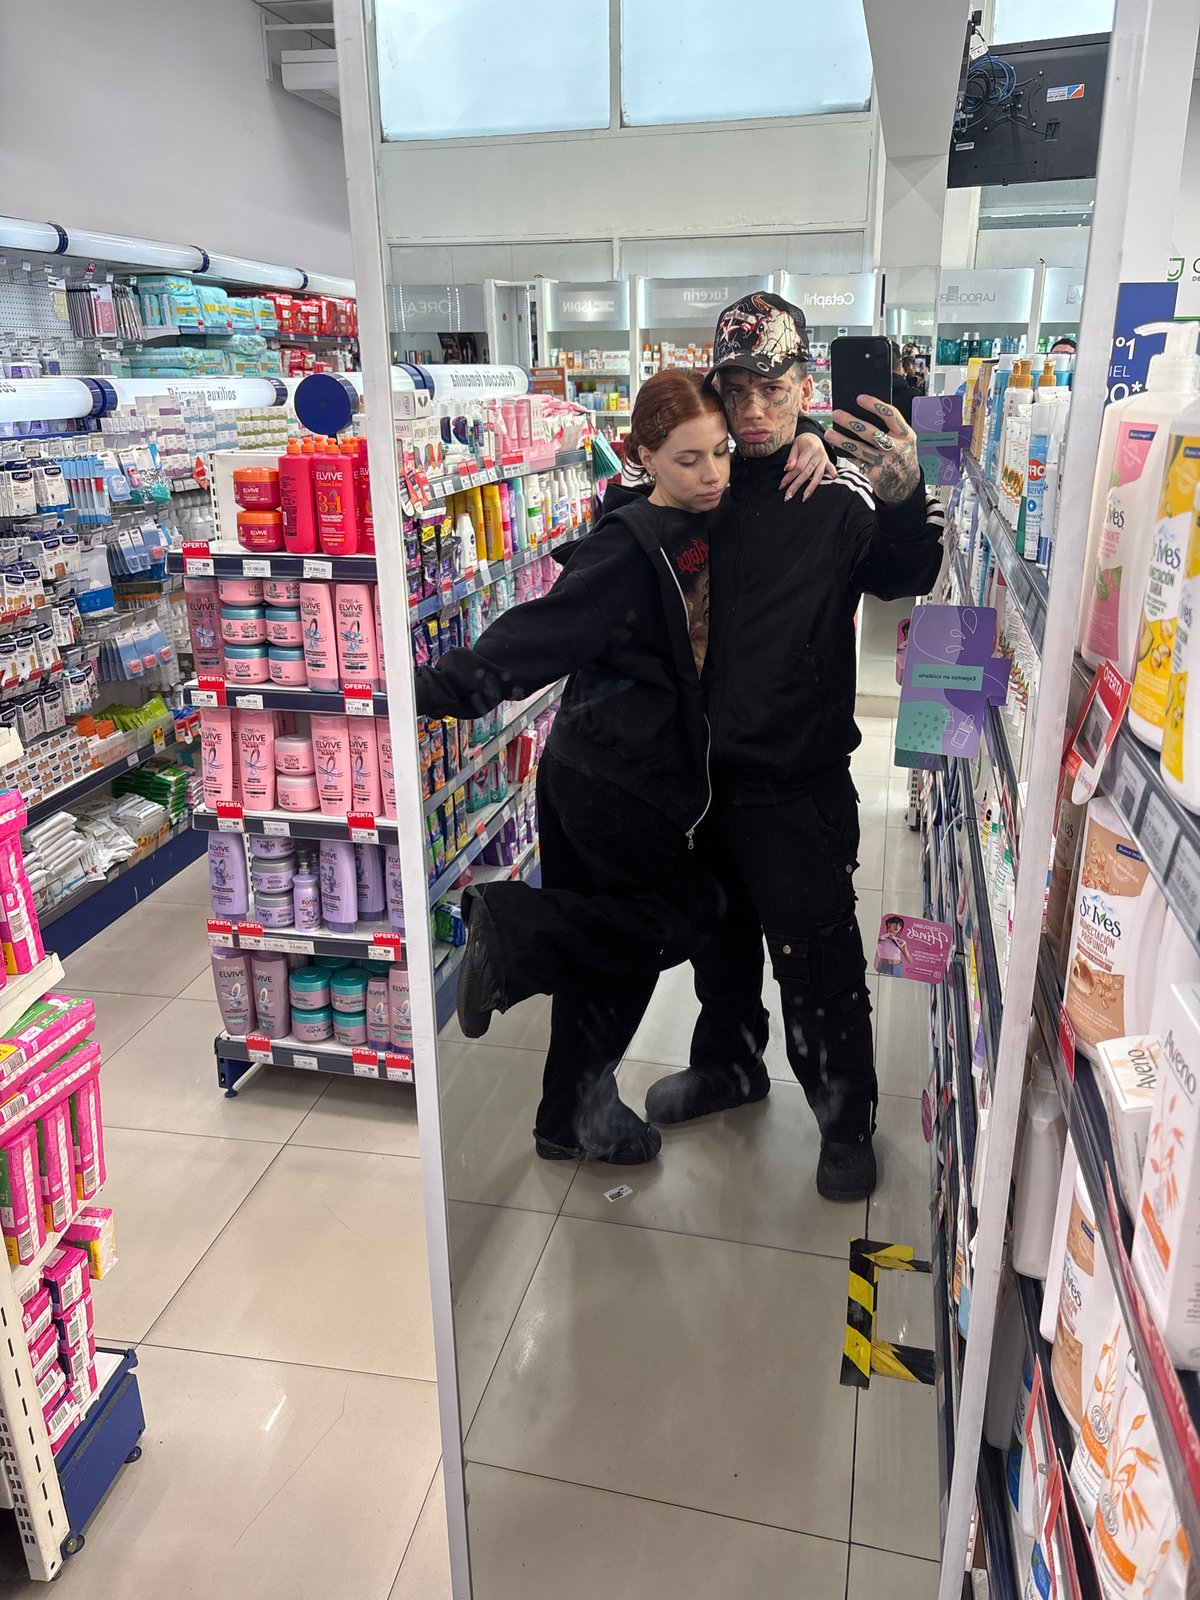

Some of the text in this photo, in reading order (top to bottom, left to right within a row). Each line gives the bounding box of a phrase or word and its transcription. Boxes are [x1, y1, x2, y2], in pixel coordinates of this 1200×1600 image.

[1108, 365, 1131, 378] IEL
[207, 386, 237, 401] auxilios
[316, 471, 343, 480] ELVIVE
[1157, 539, 1180, 569] Ives
[190, 602, 216, 611] ELVIVE
[301, 602, 321, 610] ELVIVE
[1102, 666, 1124, 700] OFERTA
[201, 733, 222, 741] ELVIVE
[241, 733, 266, 741] ELVIVE
[316, 741, 342, 749] ELVIVE
[209, 844, 230, 852] ELVIVE
[320, 852, 338, 860] ELVIVE
[1092, 904, 1121, 938] Ives
[1080, 917, 1115, 950] HUMECTACIÓN
[1081, 930, 1108, 957] PROFUNDA
[219, 969, 245, 978] ELVIVE
[368, 989, 386, 997] ELVIVE
[392, 985, 409, 993] ELVIV
[246, 1034, 269, 1042] OFERTA
[352, 1048, 377, 1056] OFERTA
[1164, 1030, 1196, 1094] Aveno
[1128, 1049, 1157, 1089] Aveno
